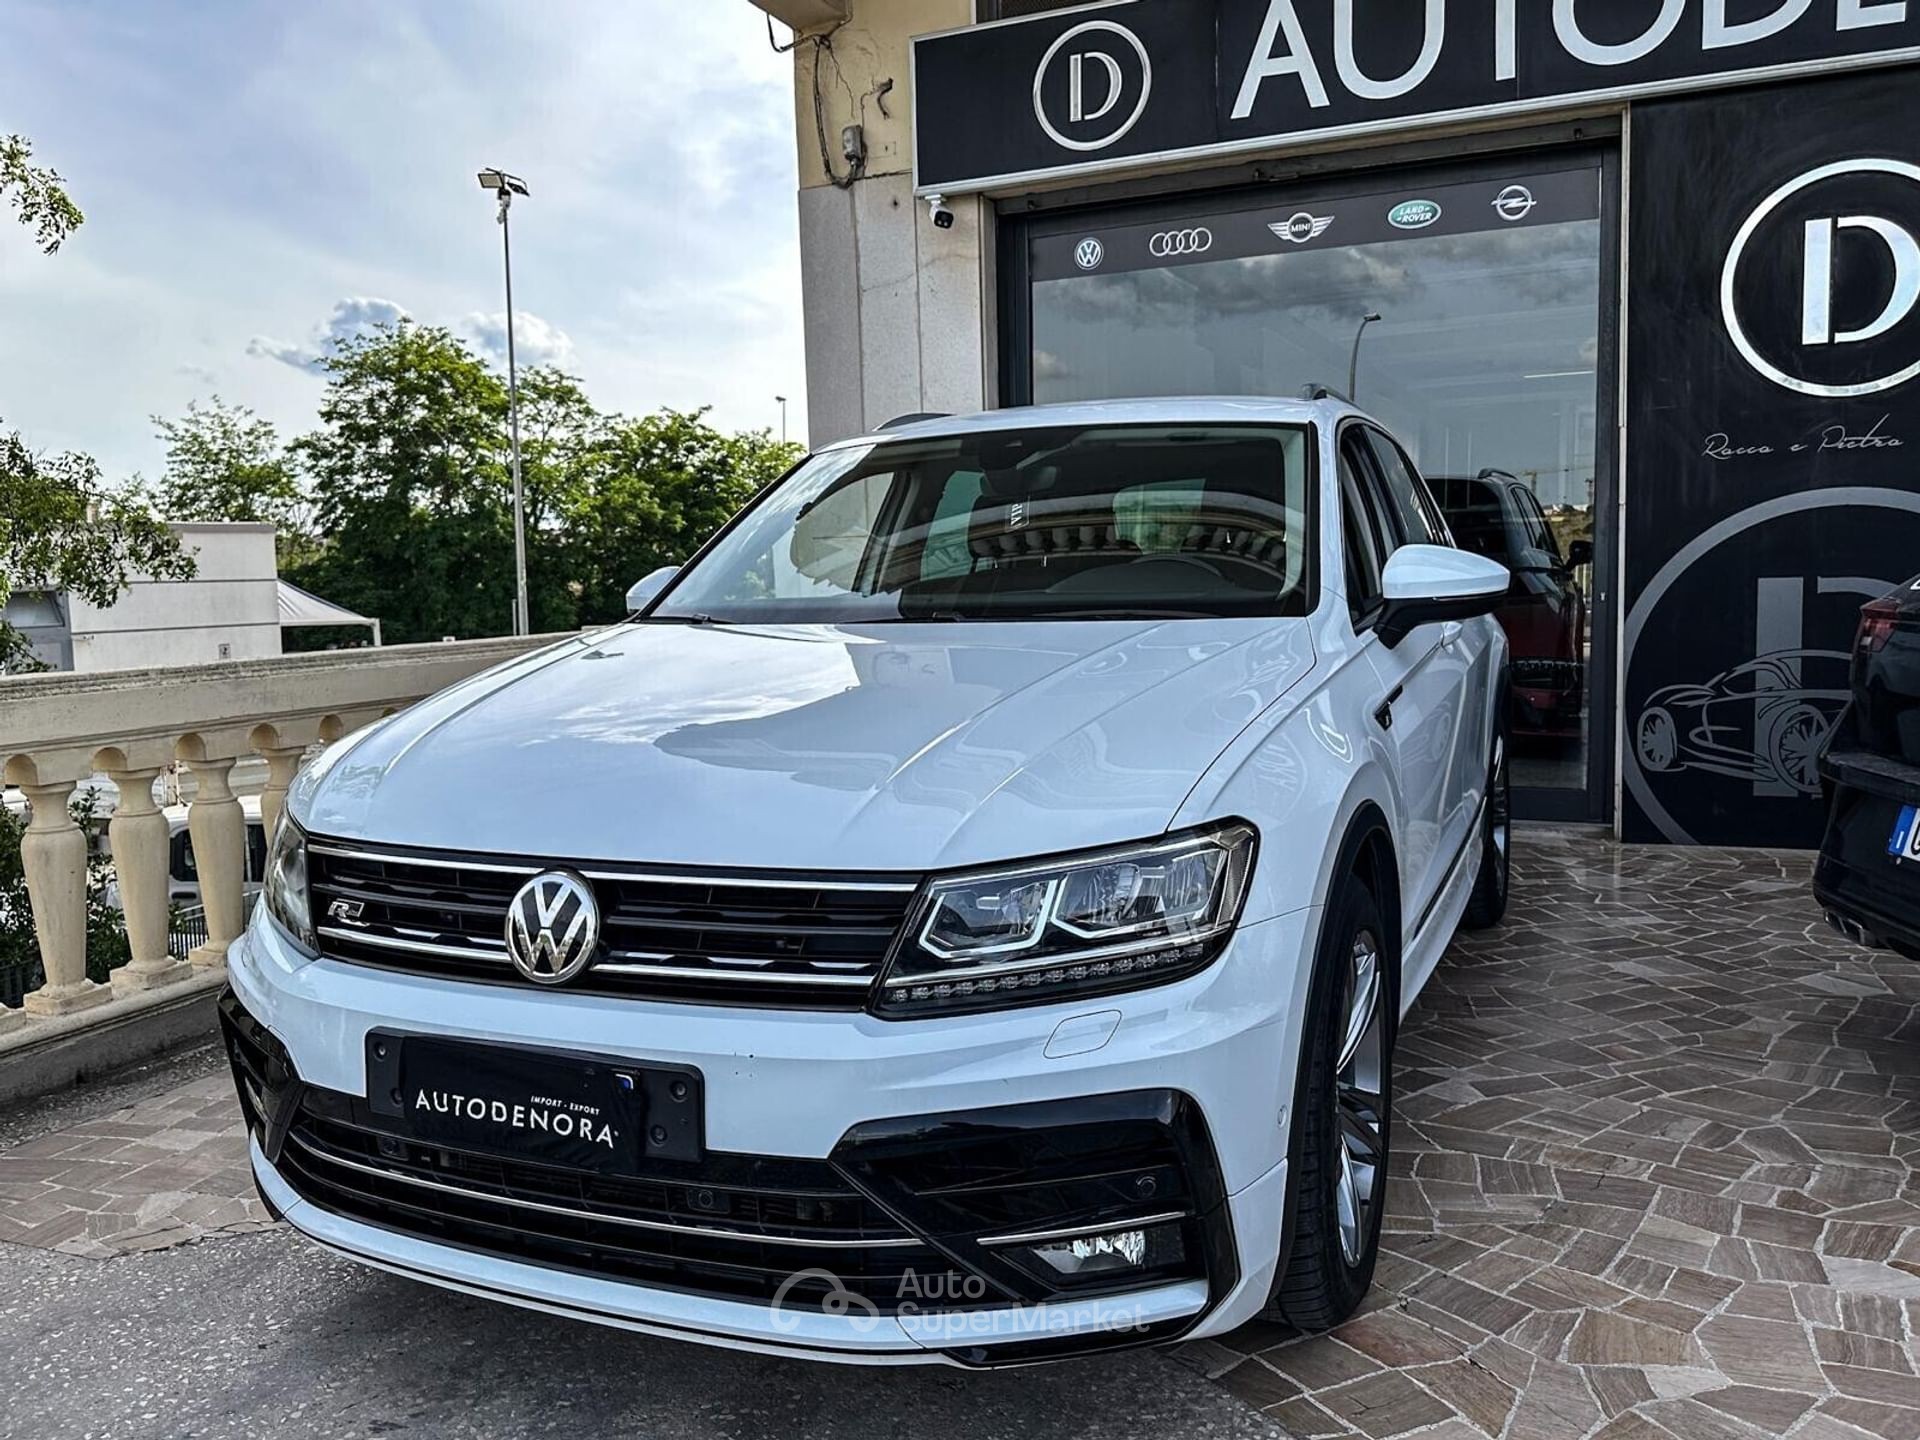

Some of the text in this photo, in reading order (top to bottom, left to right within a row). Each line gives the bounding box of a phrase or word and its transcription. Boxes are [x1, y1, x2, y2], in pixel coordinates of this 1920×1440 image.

[1230, 0, 1905, 120] AUTO
[1399, 206, 1426, 216] LAND
[1401, 212, 1433, 224] ROVER
[530, 1095, 562, 1108] IMPORT
[569, 1102, 600, 1116] EXPORT
[415, 1088, 614, 1149] AUTODENORA
